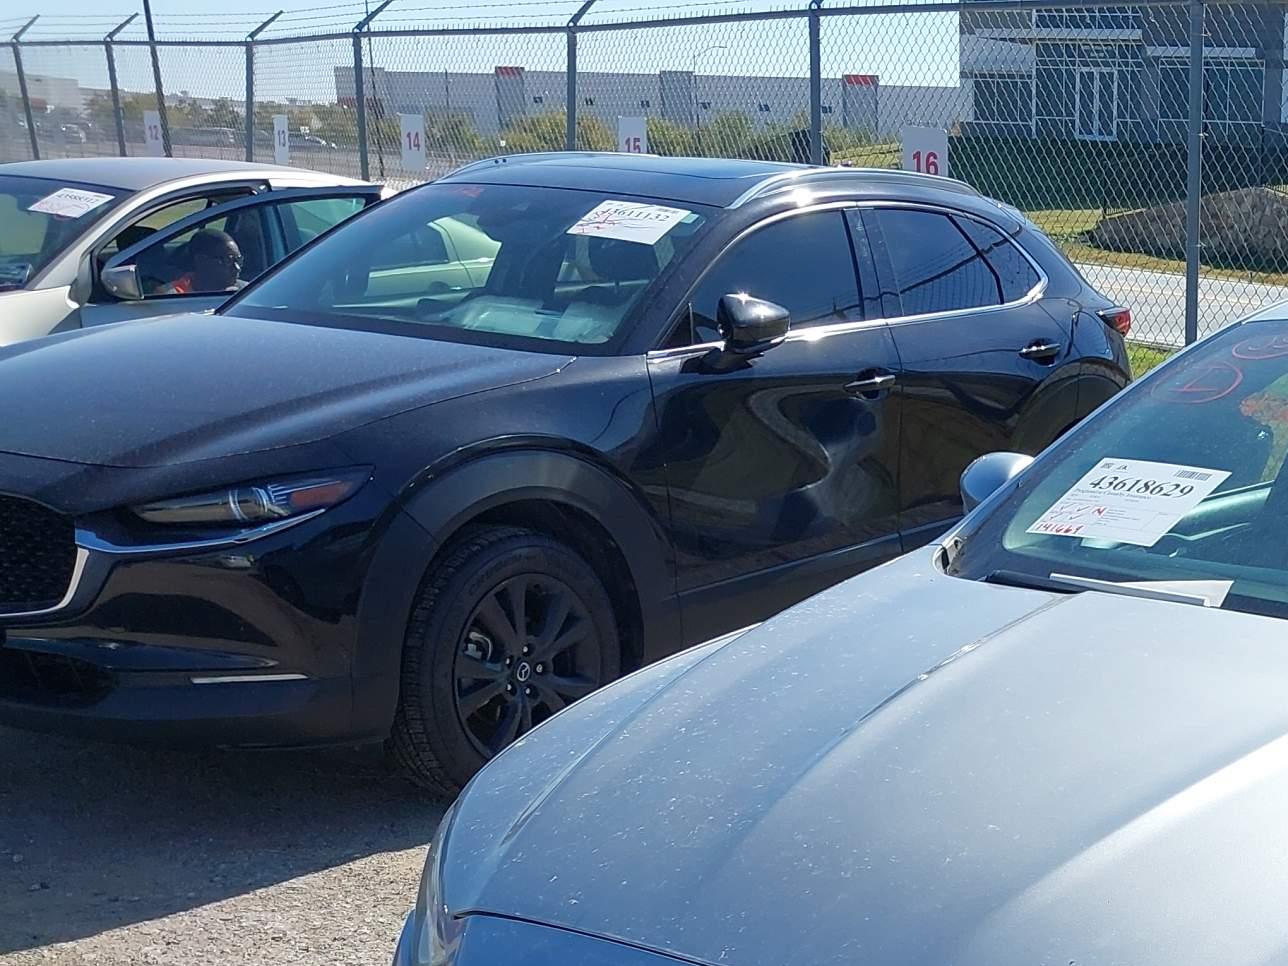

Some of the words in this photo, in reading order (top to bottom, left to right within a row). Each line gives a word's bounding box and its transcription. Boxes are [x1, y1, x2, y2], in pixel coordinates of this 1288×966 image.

[149, 124, 159, 141] 12
[277, 129, 286, 147] 13
[405, 131, 421, 151] 14
[624, 137, 641, 154] 15
[913, 151, 939, 176] 16
[1089, 475, 1195, 498] 43618629
